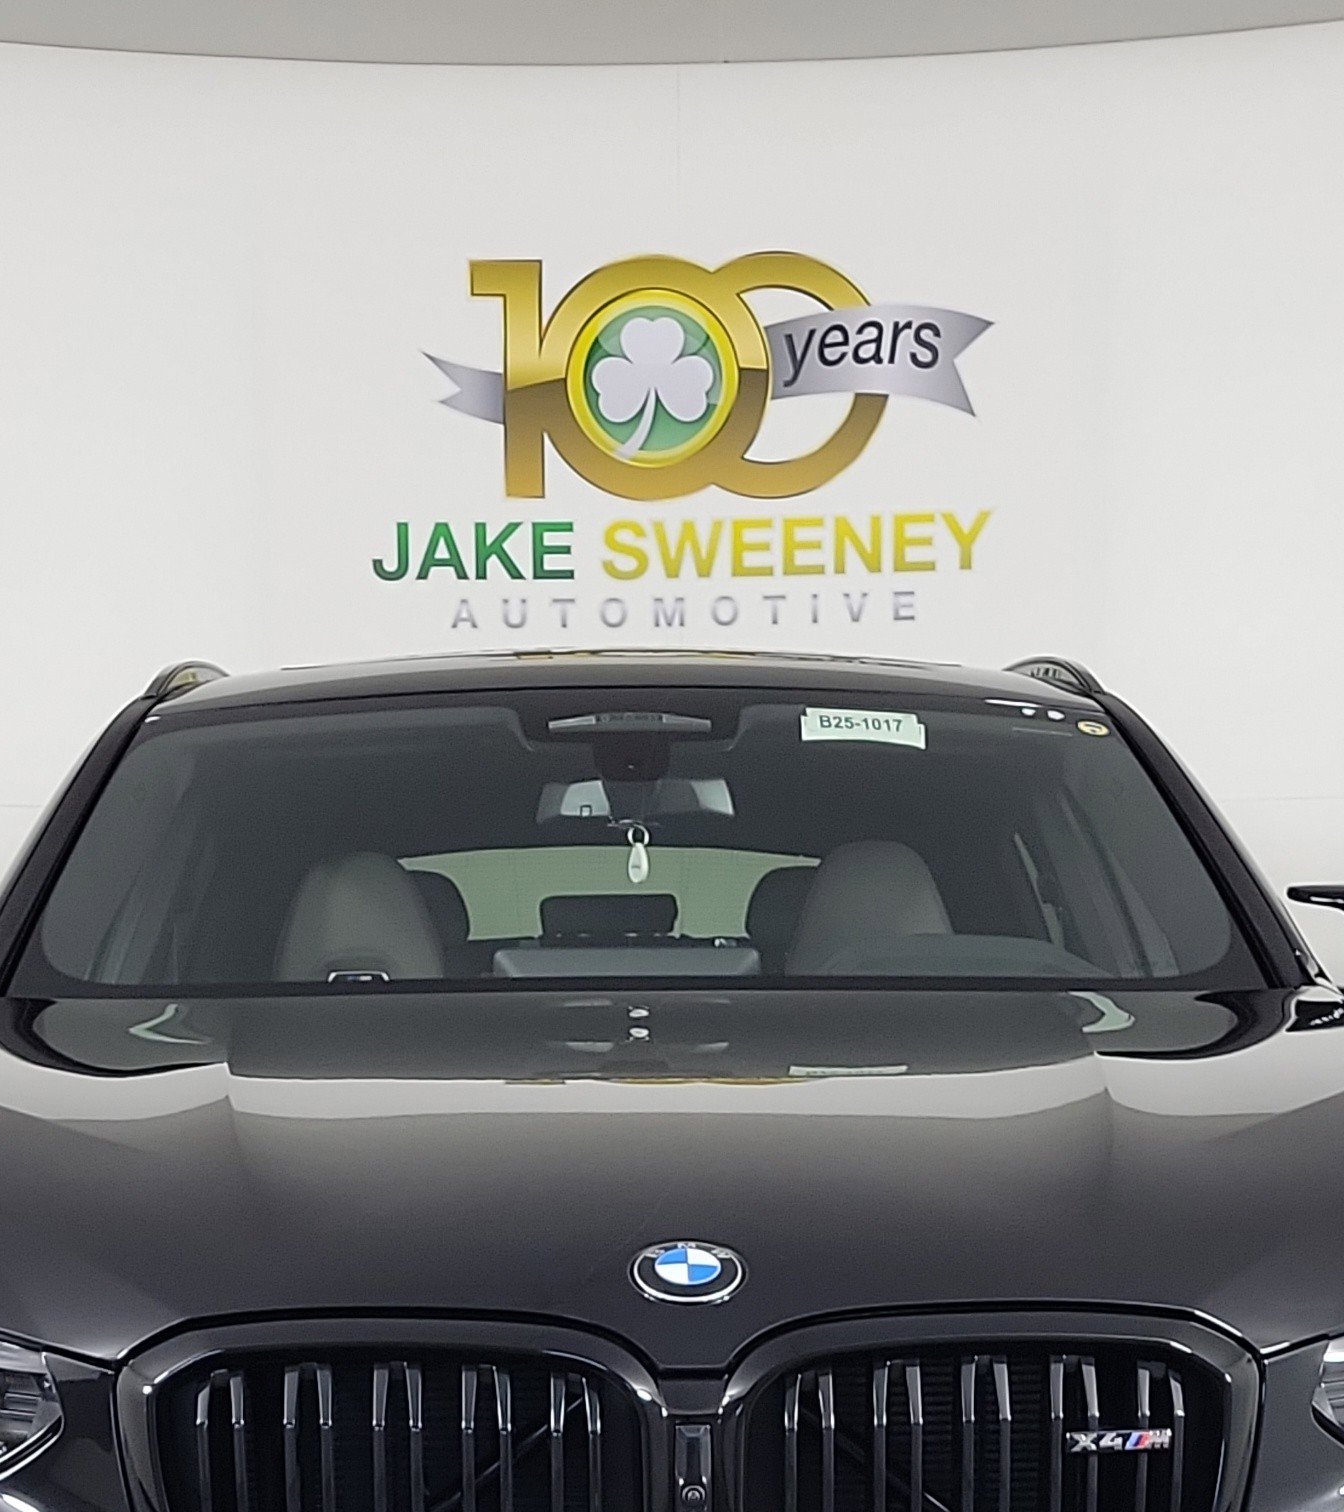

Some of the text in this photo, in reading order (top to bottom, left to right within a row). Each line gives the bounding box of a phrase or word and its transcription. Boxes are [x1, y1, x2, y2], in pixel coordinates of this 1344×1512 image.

[469, 251, 941, 501] 100 years
[372, 510, 991, 582] JAKE SWEENEY
[451, 591, 916, 629] AUTOMOTIVE
[819, 714, 903, 732] B25-1017
